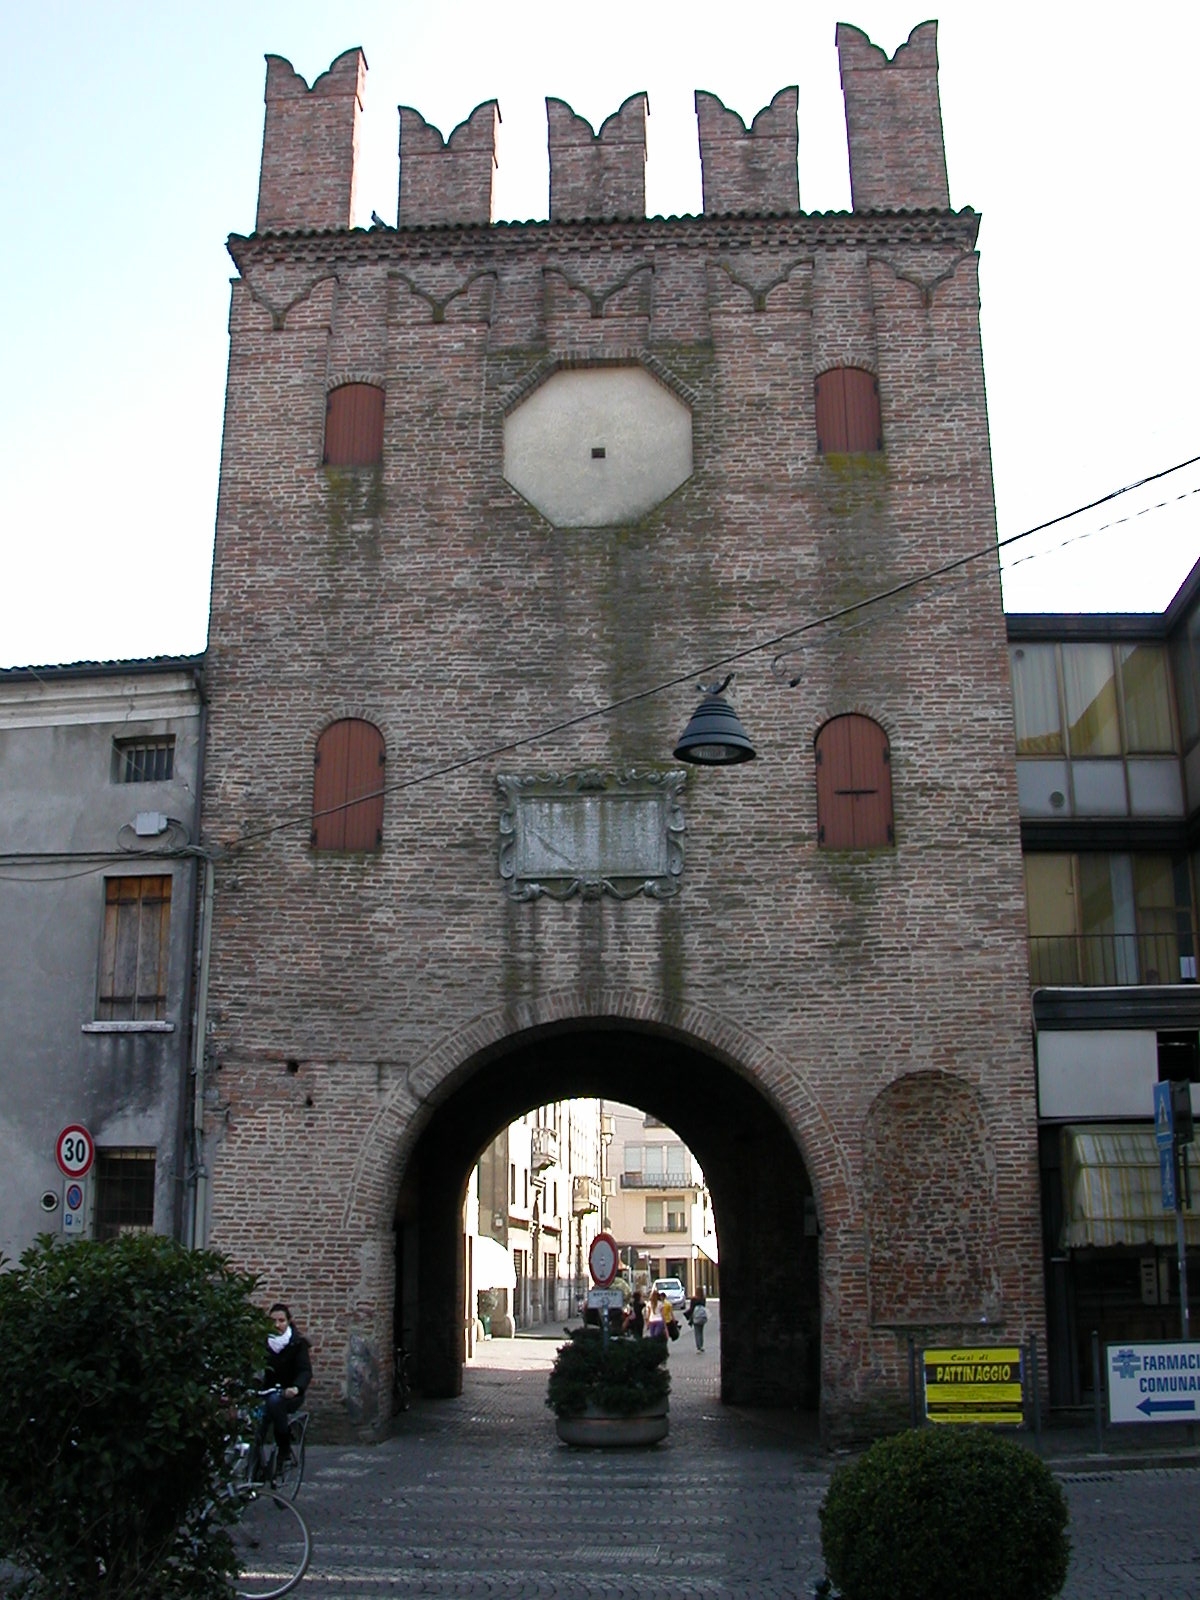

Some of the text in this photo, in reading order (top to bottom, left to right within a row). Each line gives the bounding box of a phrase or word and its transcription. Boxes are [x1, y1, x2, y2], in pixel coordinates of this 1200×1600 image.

[64, 1138, 86, 1163] 30
[978, 1353, 990, 1361] di
[1143, 1354, 1200, 1371] FARMACI
[936, 1365, 1011, 1382] PATTINAGGIO
